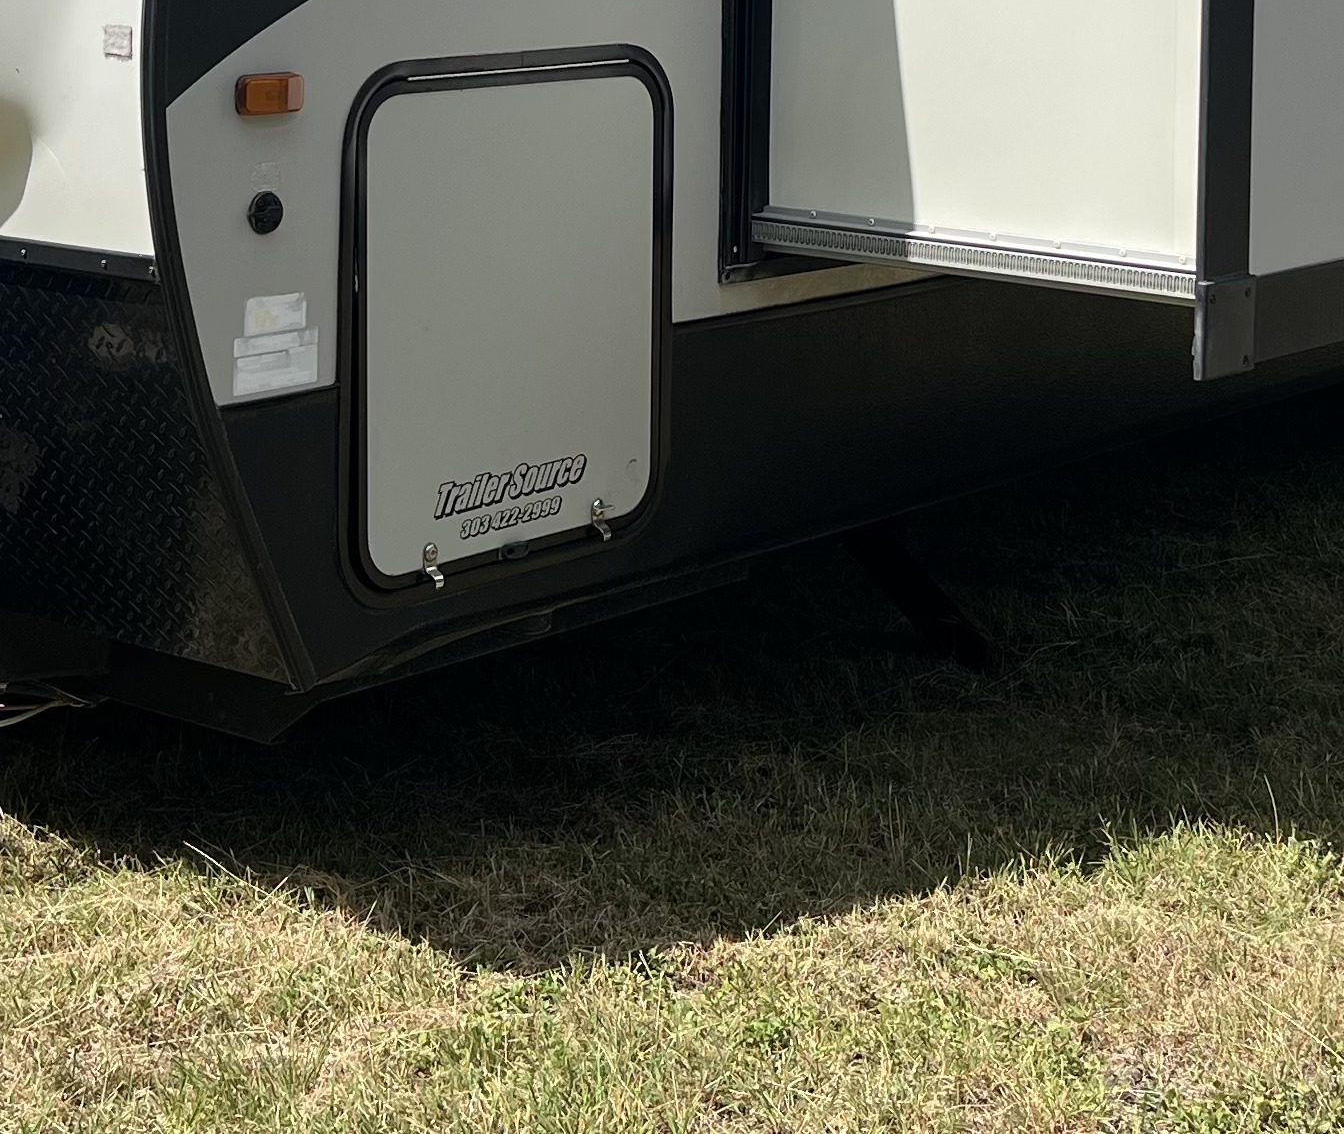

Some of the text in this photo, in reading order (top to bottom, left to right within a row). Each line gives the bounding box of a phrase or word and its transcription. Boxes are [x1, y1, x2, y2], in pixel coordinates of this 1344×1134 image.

[434, 454, 587, 520] Trailer Source
[460, 496, 562, 540] 303 422-2999
